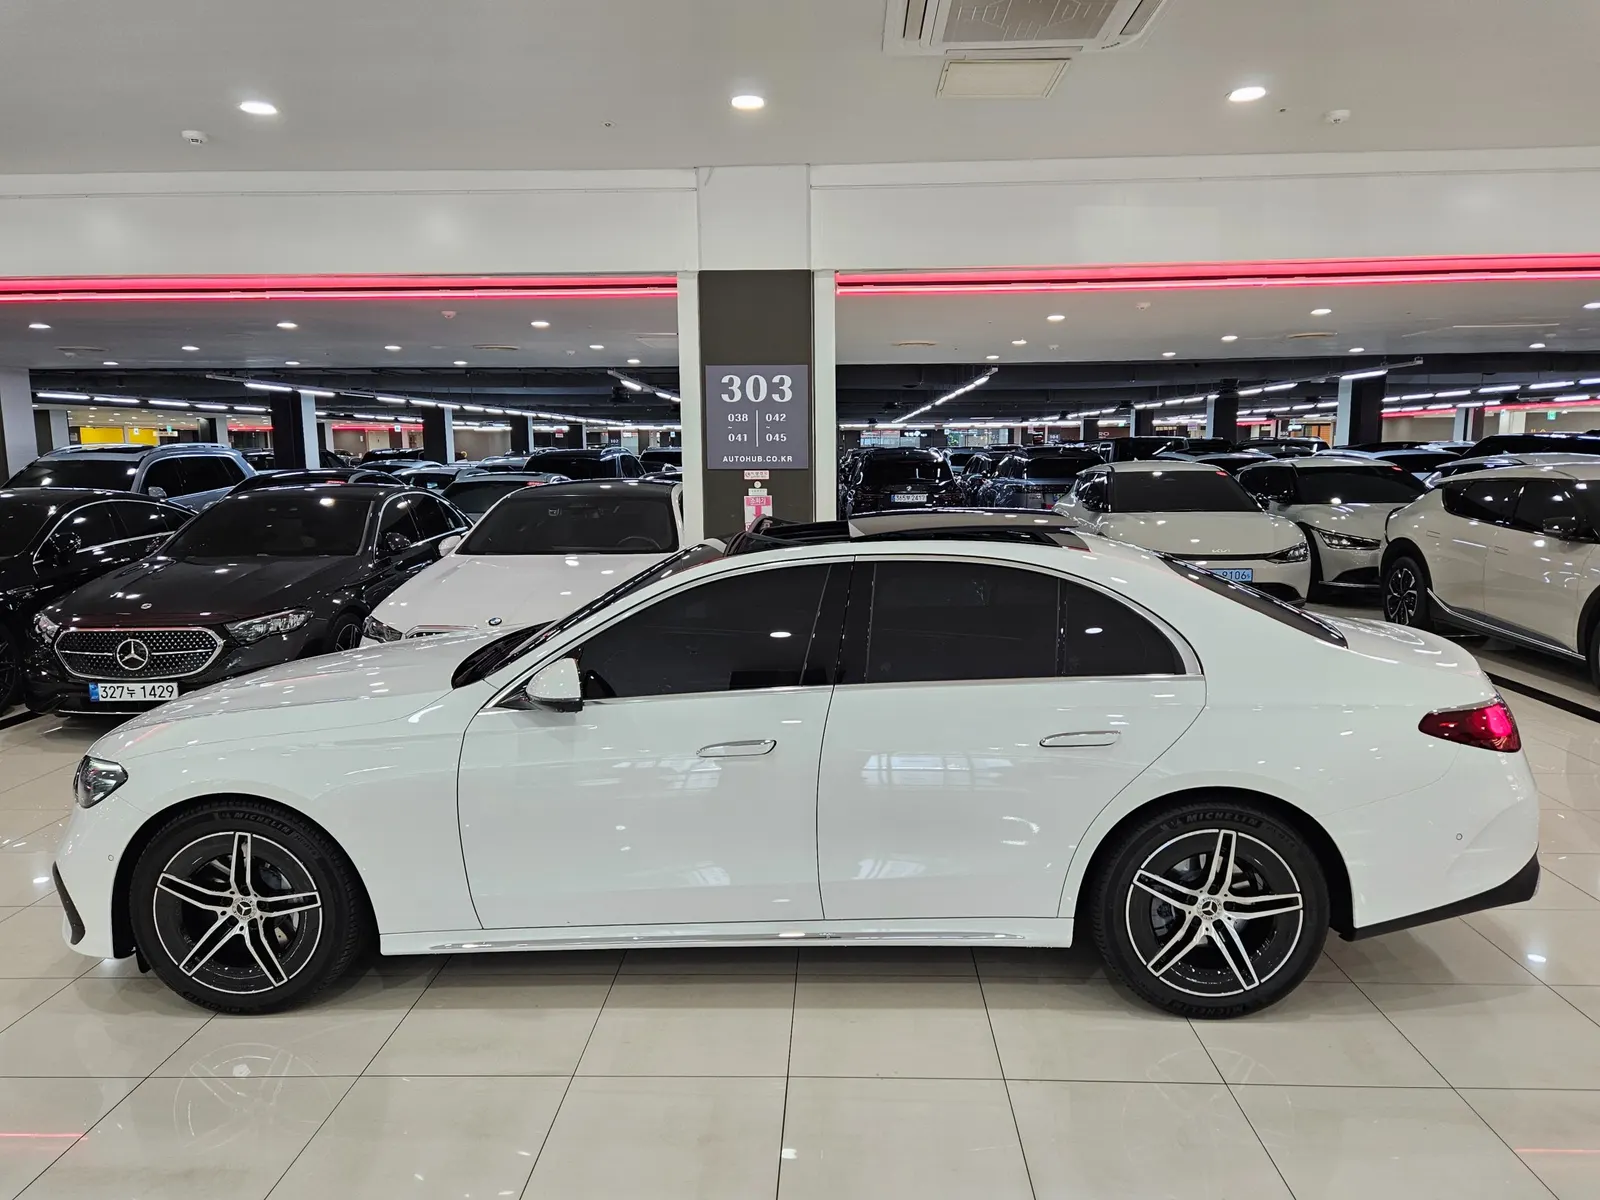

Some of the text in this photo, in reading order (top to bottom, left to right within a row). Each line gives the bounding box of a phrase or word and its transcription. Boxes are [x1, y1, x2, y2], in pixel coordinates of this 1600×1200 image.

[720, 374, 793, 403] 303
[727, 413, 749, 422] 038
[765, 413, 787, 422] 042
[727, 433, 748, 442] 041
[765, 433, 787, 442] 045
[722, 455, 793, 463] AUTOHUB.CO.KR
[100, 684, 174, 699] 327누 1429
[233, 811, 291, 835] MICHELIN
[1186, 811, 1258, 826] MICHELIN
